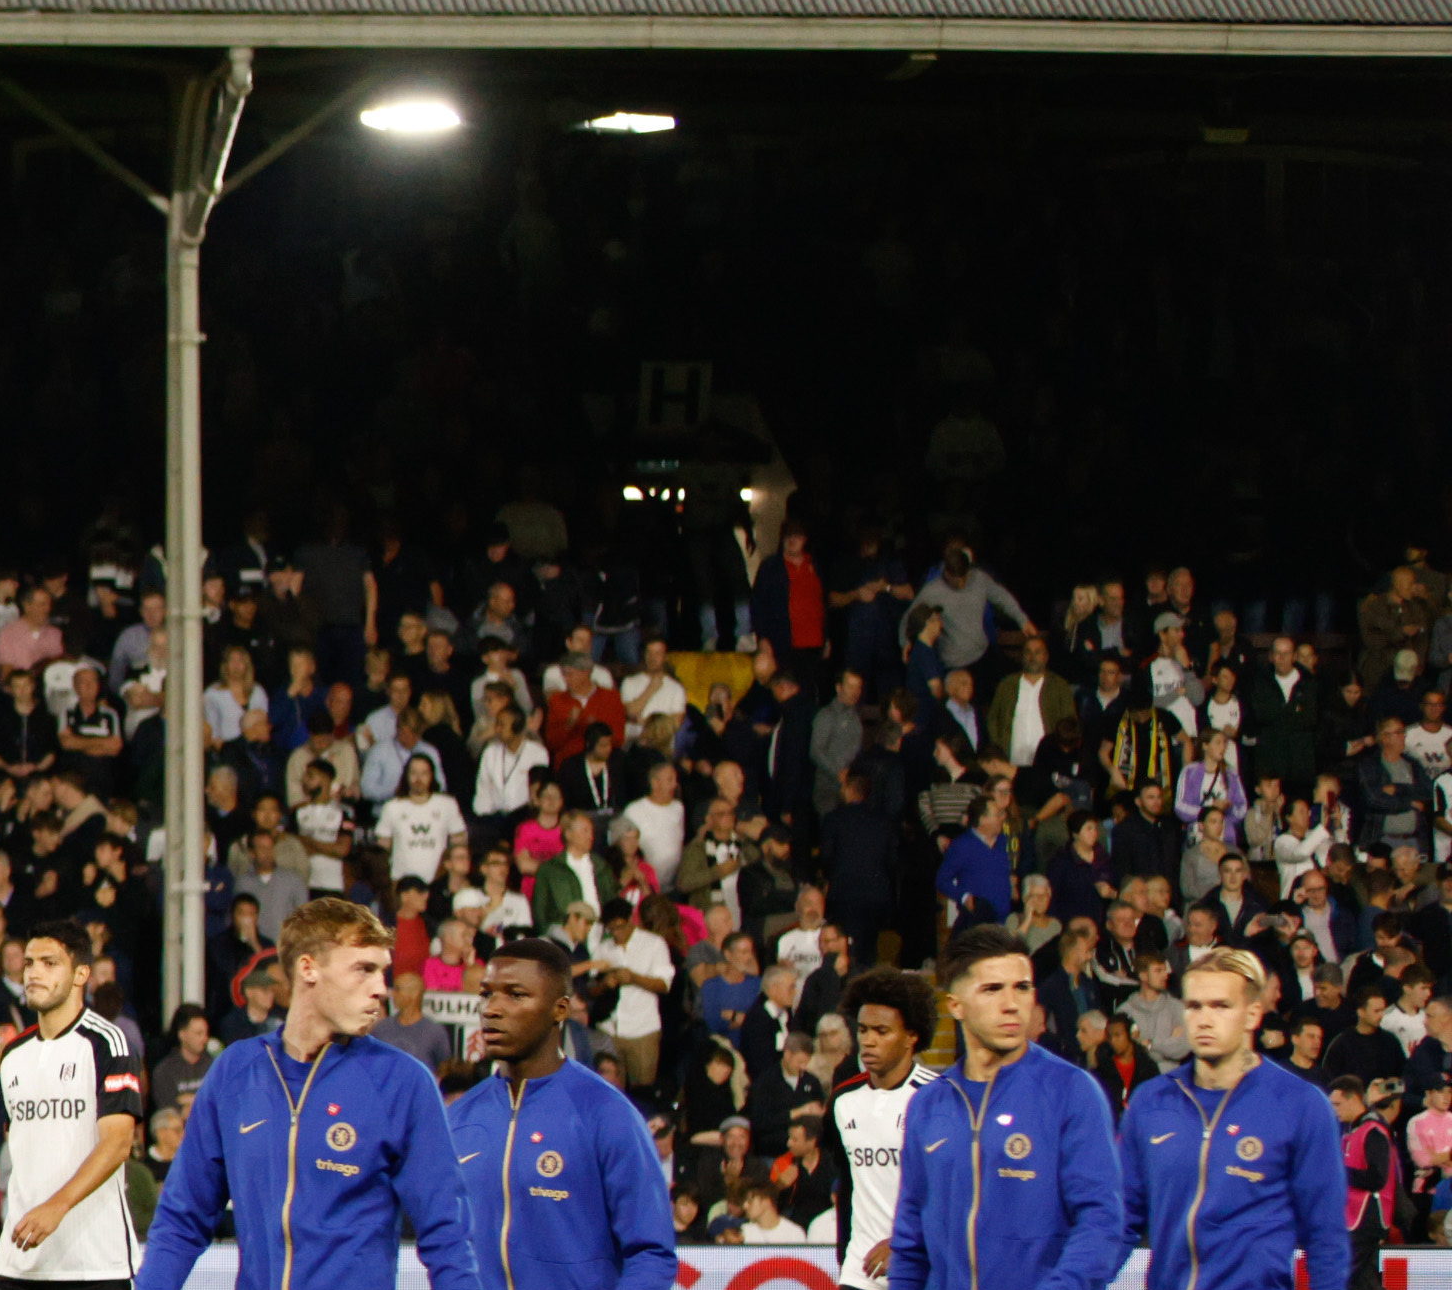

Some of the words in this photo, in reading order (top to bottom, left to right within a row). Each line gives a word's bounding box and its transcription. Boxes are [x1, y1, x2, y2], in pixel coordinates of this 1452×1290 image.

[650, 367, 702, 424] H
[15, 1098, 87, 1122] SBOTOP
[315, 1158, 360, 1177] trivago
[853, 1147, 899, 1167] SBOT
